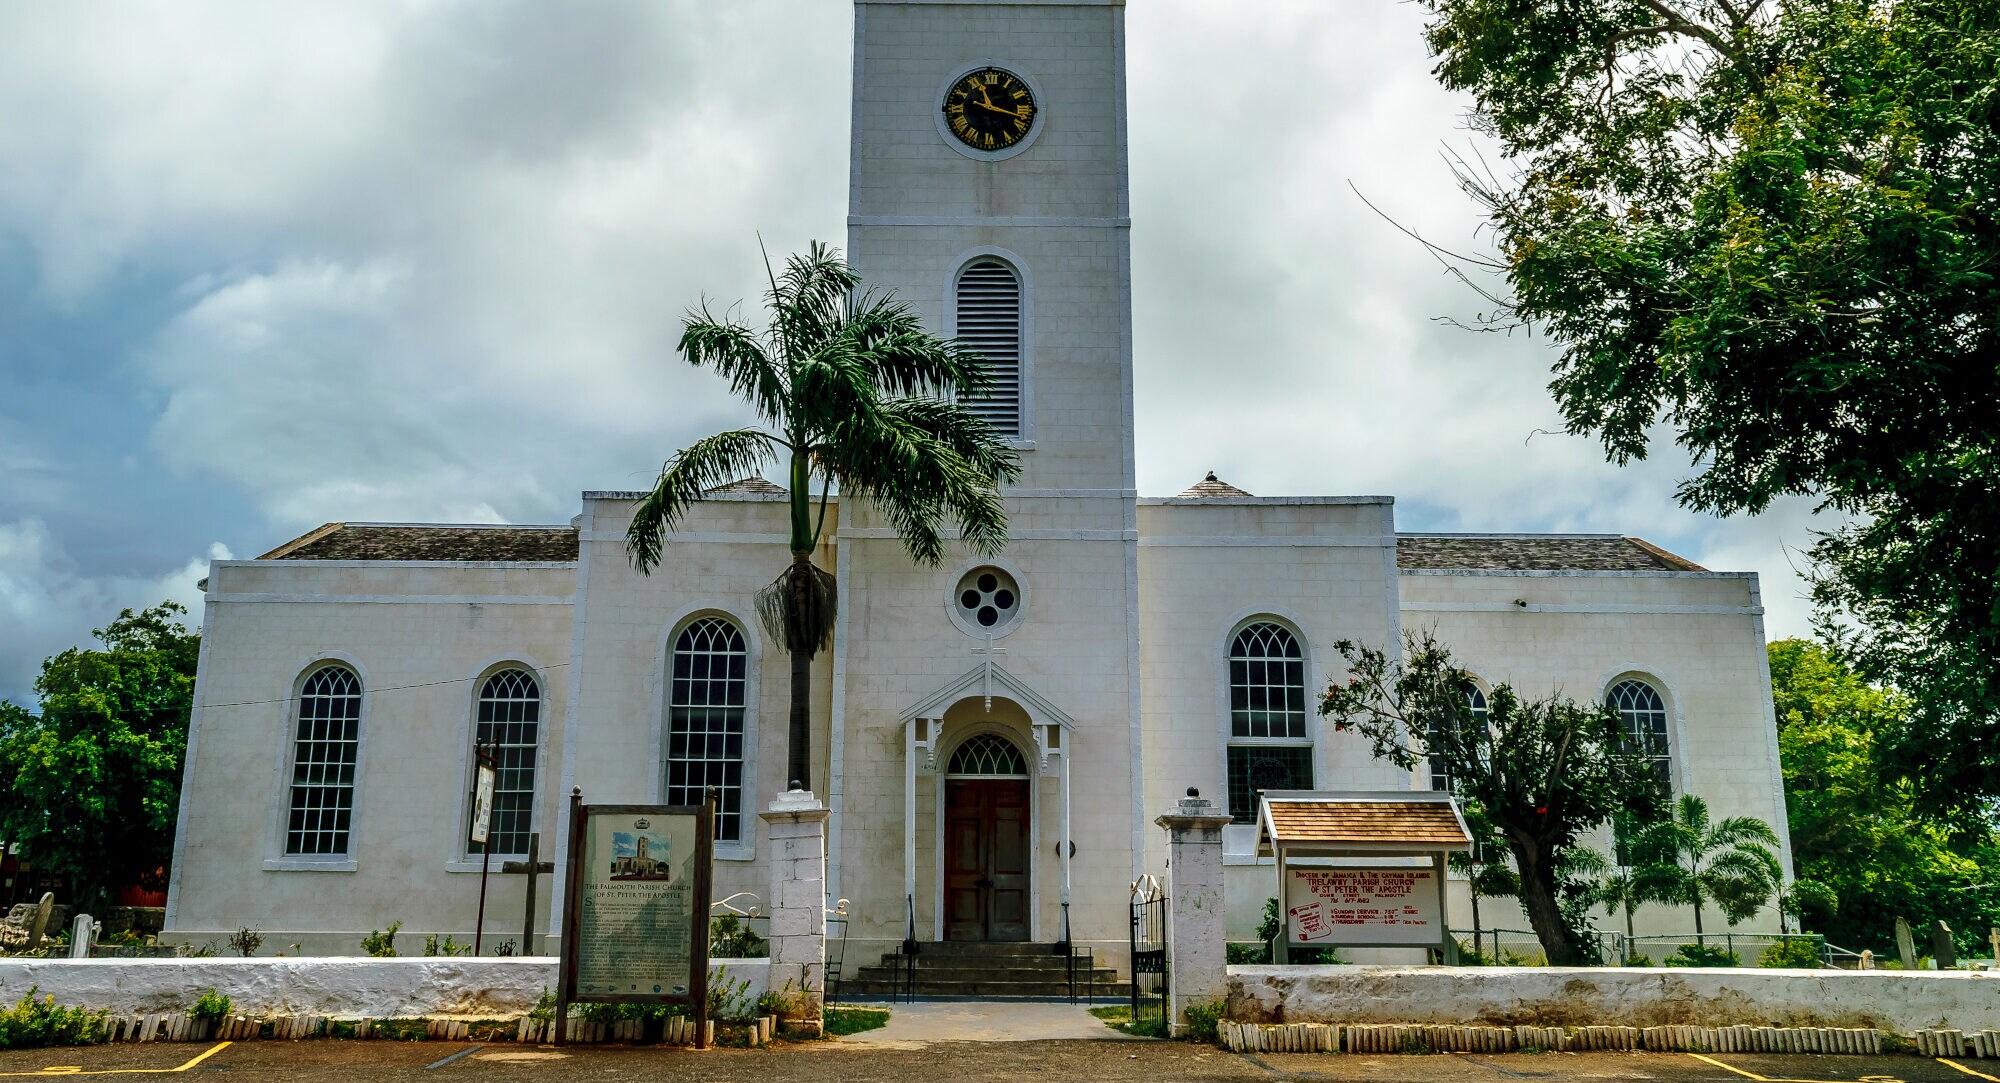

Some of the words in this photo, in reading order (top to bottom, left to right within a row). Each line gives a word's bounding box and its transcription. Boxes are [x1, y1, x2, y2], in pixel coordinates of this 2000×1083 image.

[600, 883, 635, 891] FALMOUTH
[637, 883, 660, 891] PARISH
[1311, 886, 1320, 894] OF
[1321, 886, 1330, 894] ST
[1334, 886, 1359, 894] PETER
[1361, 886, 1375, 894] THE
[1378, 886, 1412, 894] APOSTLE
[652, 891, 681, 899] APOSTLE
